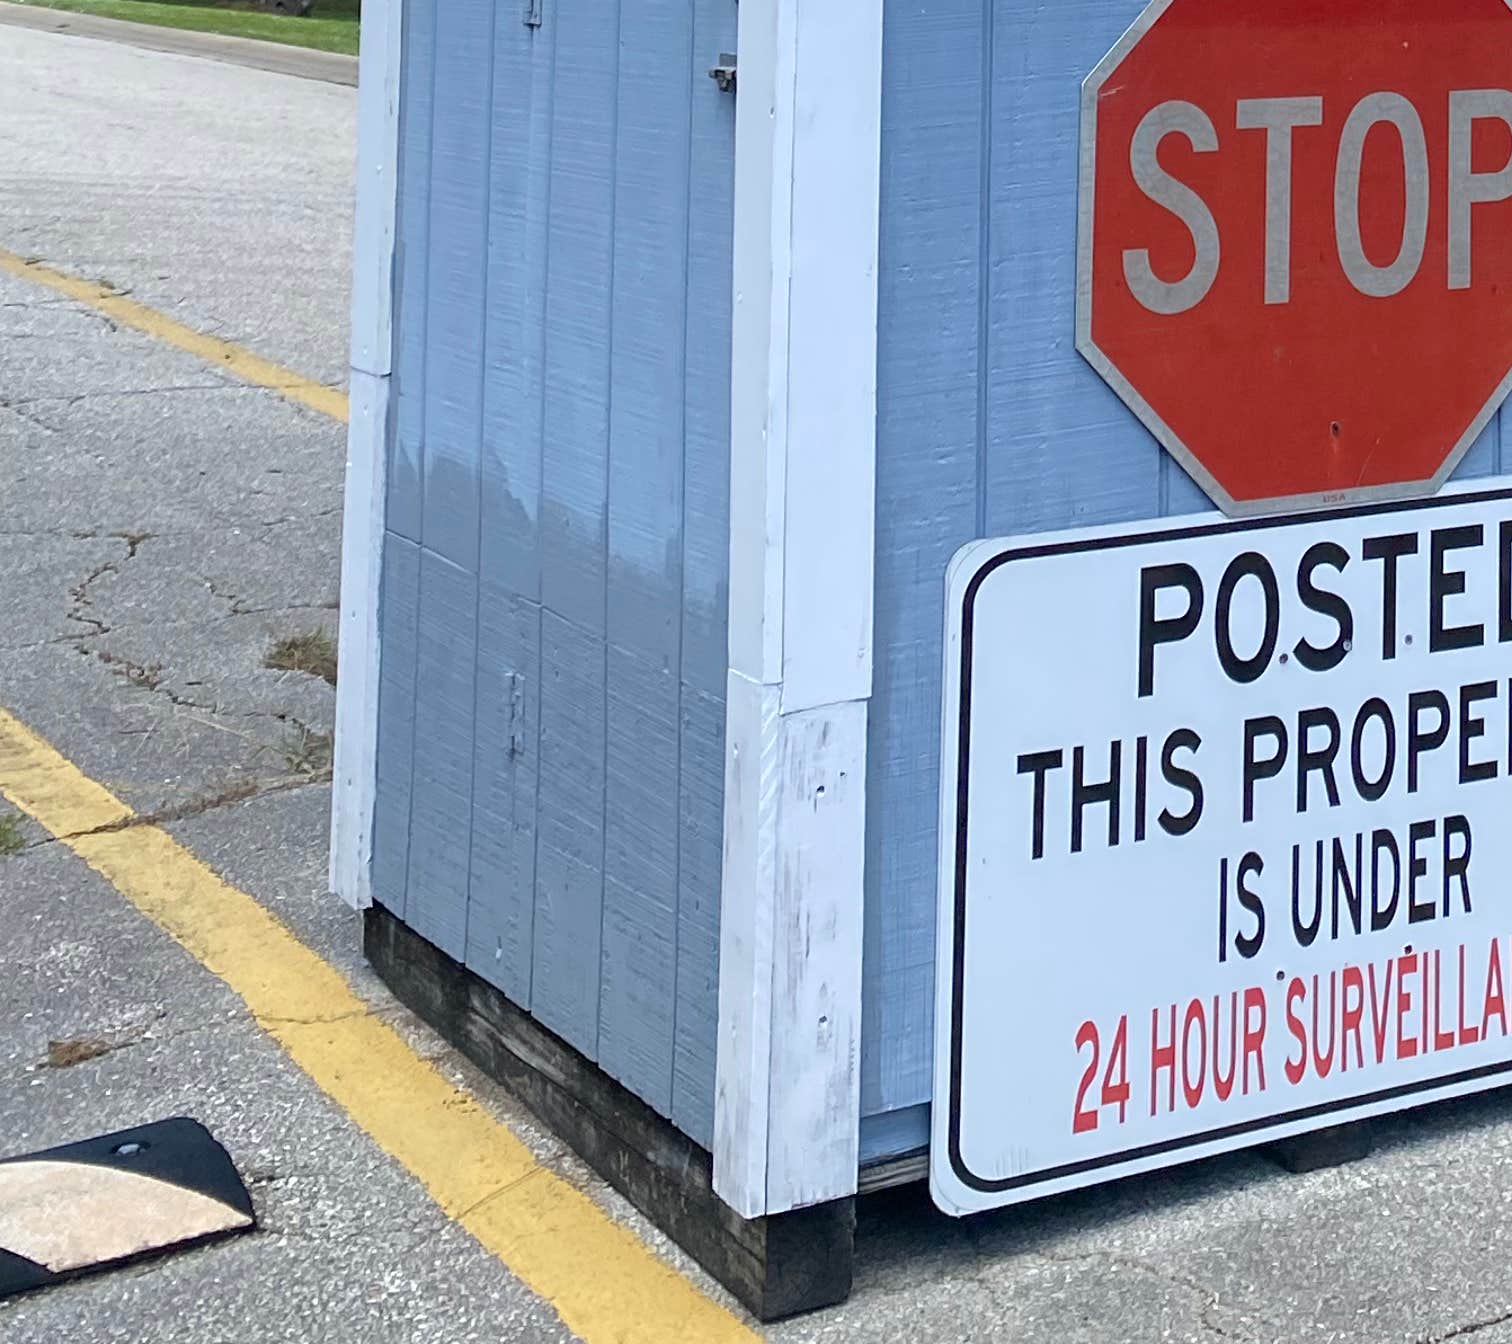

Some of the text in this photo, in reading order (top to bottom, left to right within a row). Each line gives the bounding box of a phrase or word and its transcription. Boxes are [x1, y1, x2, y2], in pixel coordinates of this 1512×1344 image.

[1322, 493, 1346, 503] USA
[1016, 727, 1203, 860] THIS
[1218, 813, 1472, 964] IS UNDER
[1072, 1015, 1130, 1136] 24
[1148, 986, 1267, 1117] HOUR
